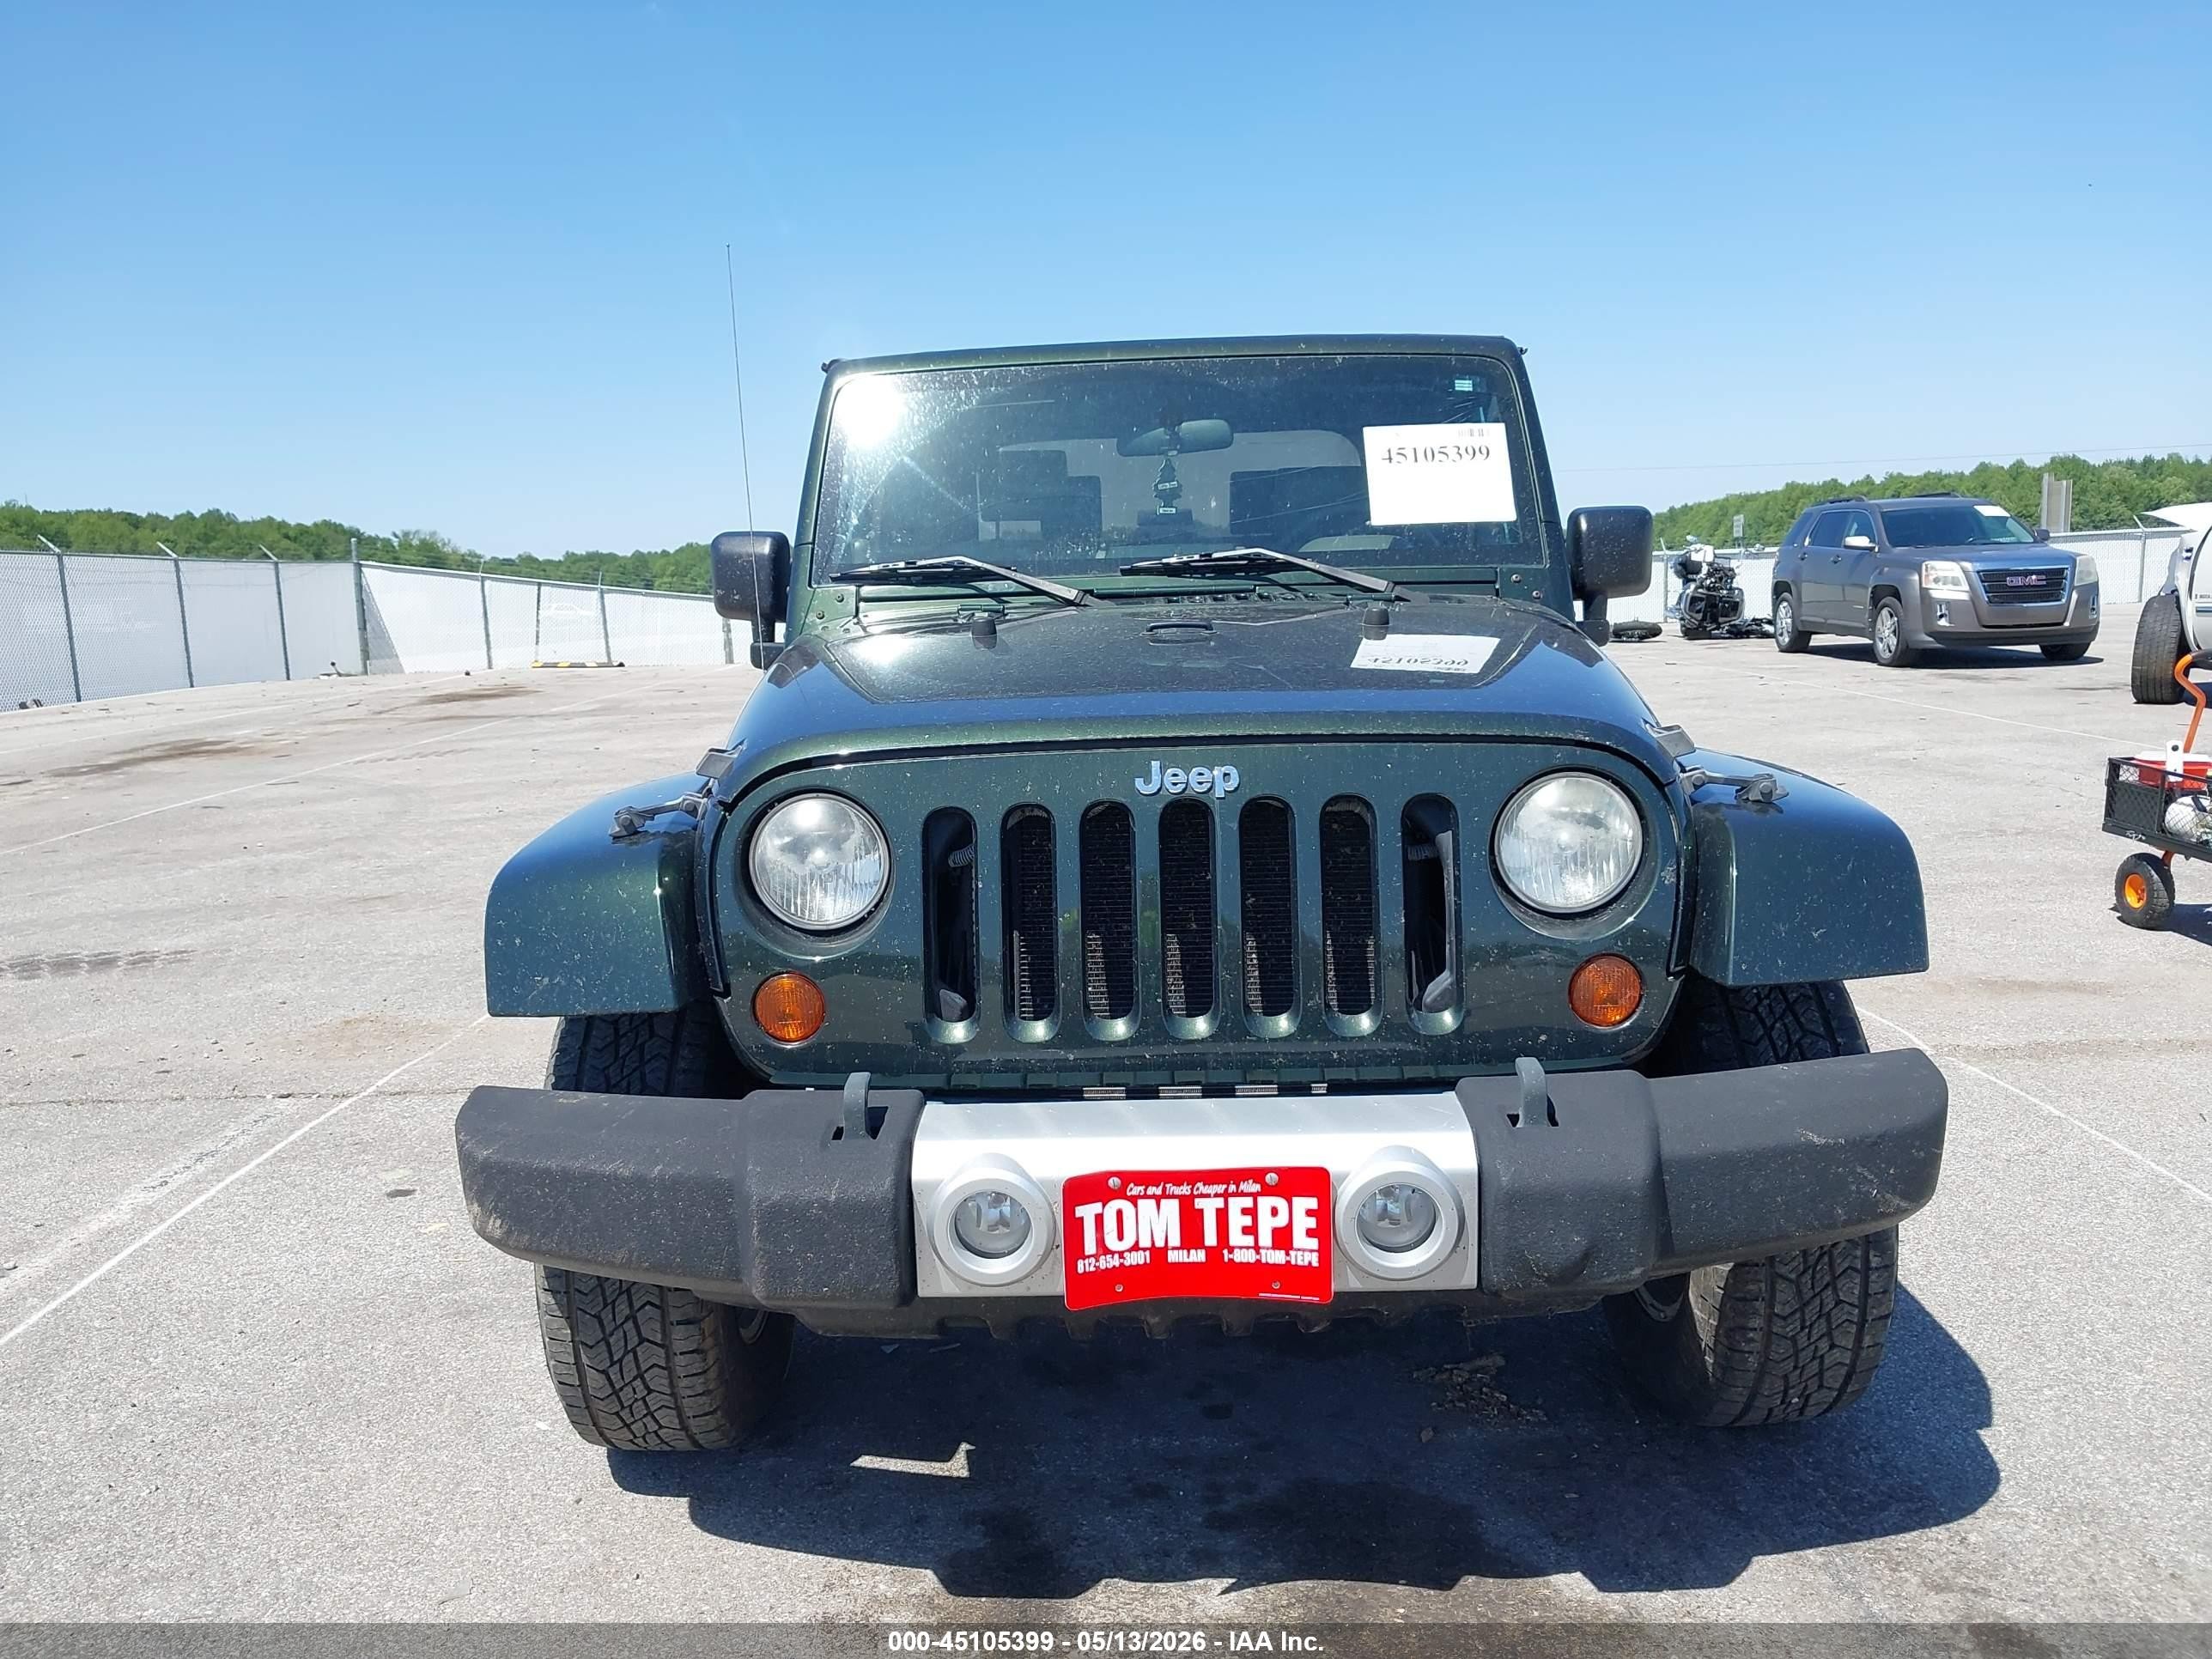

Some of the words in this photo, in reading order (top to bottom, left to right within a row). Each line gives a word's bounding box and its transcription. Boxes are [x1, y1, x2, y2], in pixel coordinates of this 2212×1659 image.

[1381, 444, 1491, 464] 45105399
[2006, 574, 2047, 586] GMC
[1134, 760, 1240, 799] Jeep
[1126, 1182, 1145, 1196] Cars
[1146, 1182, 1164, 1195] and
[1165, 1181, 1191, 1195] Trucks
[1193, 1180, 1227, 1197] Cheaper
[1228, 1181, 1237, 1193] in
[1238, 1178, 1261, 1193] Milan
[1074, 1198, 1181, 1255] TOM
[1194, 1195, 1320, 1249] TEPE
[1077, 1250, 1151, 1273] 812-654-3001
[1167, 1249, 1206, 1263] MILAN
[1223, 1249, 1320, 1267] 1-800-TOM-TEPE
